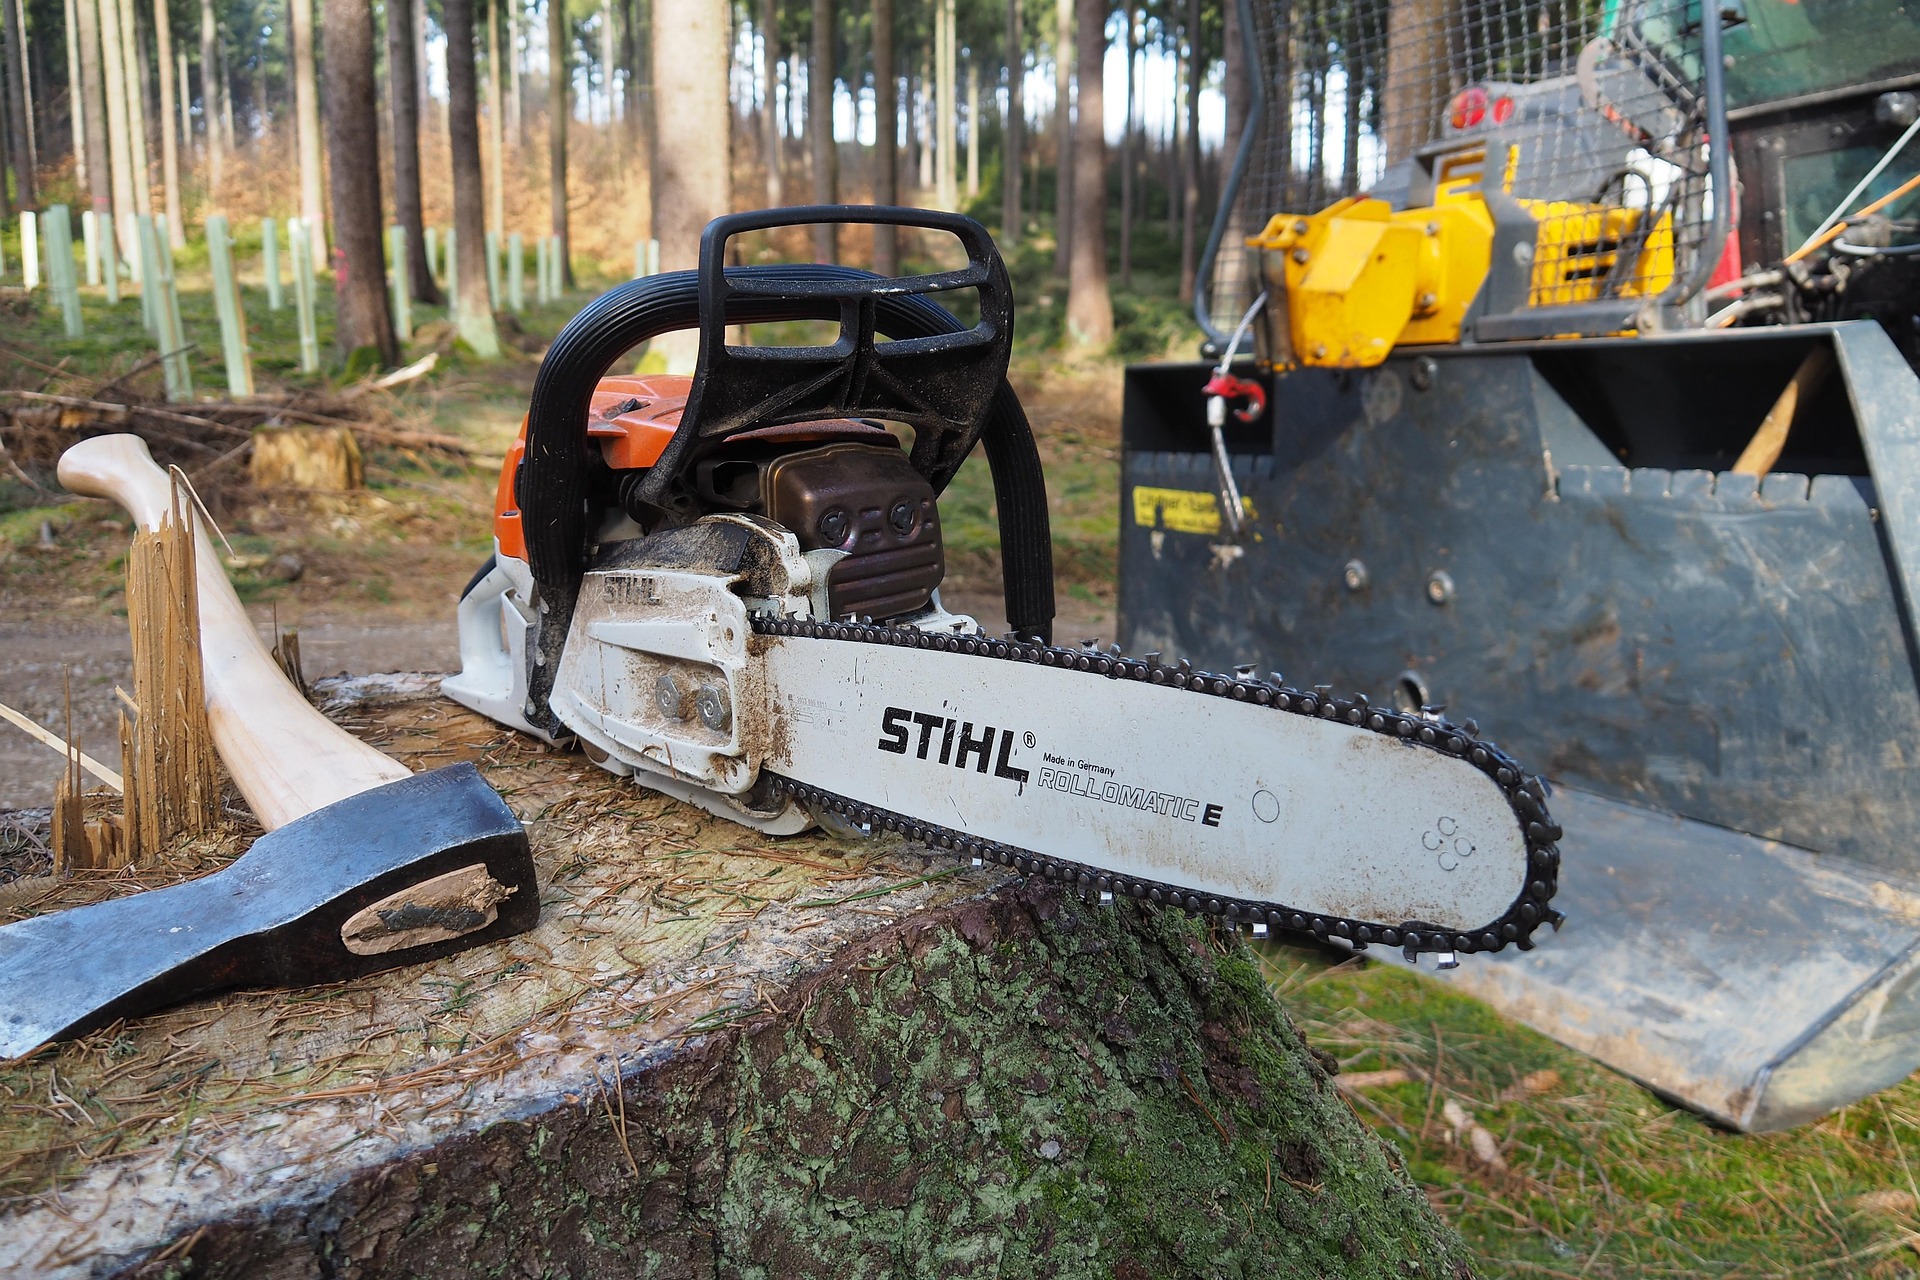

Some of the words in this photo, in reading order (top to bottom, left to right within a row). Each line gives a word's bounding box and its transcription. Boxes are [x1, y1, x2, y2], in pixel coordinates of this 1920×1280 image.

[604, 576, 661, 605] STIHL
[1043, 752, 1065, 766] Made
[1067, 757, 1075, 768] in
[1077, 759, 1115, 778] Germany
[1038, 767, 1200, 822] ROLLOMATIC
[1202, 803, 1223, 828] E
